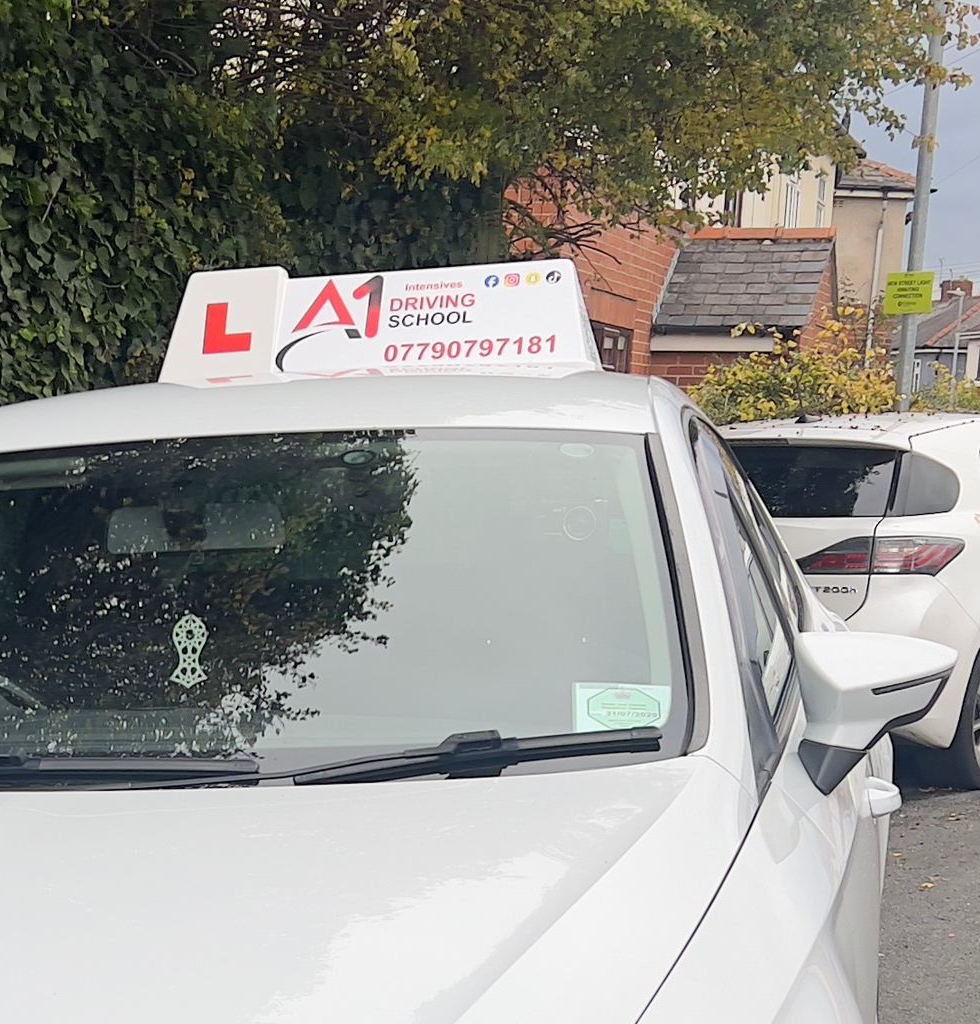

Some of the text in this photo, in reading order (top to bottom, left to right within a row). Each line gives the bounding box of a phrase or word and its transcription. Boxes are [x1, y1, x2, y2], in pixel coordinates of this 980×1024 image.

[405, 280, 463, 291] Intensives
[291, 275, 384, 339] A1
[389, 293, 476, 312] DRIVING
[388, 310, 473, 328] SCHOOL
[202, 303, 252, 355] L
[384, 334, 557, 363] 07790797181
[811, 586, 857, 594] T200h
